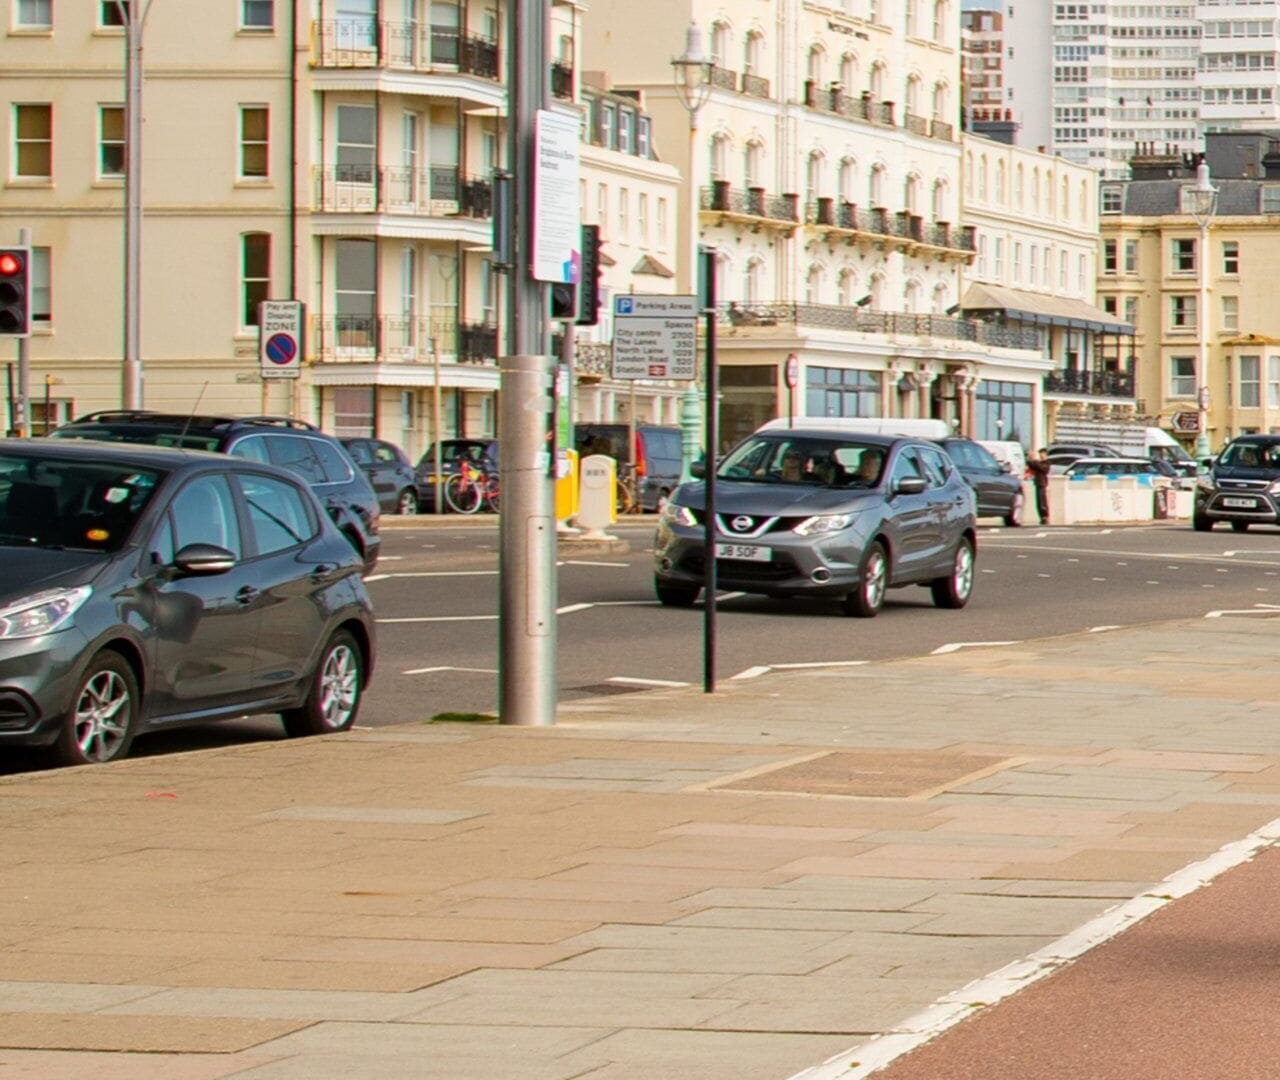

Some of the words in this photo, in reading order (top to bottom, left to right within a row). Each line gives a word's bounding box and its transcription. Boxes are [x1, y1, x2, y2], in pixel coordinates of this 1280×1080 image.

[636, 302, 667, 311] Parking
[669, 302, 693, 310] Areas
[265, 322, 297, 331] ZONE
